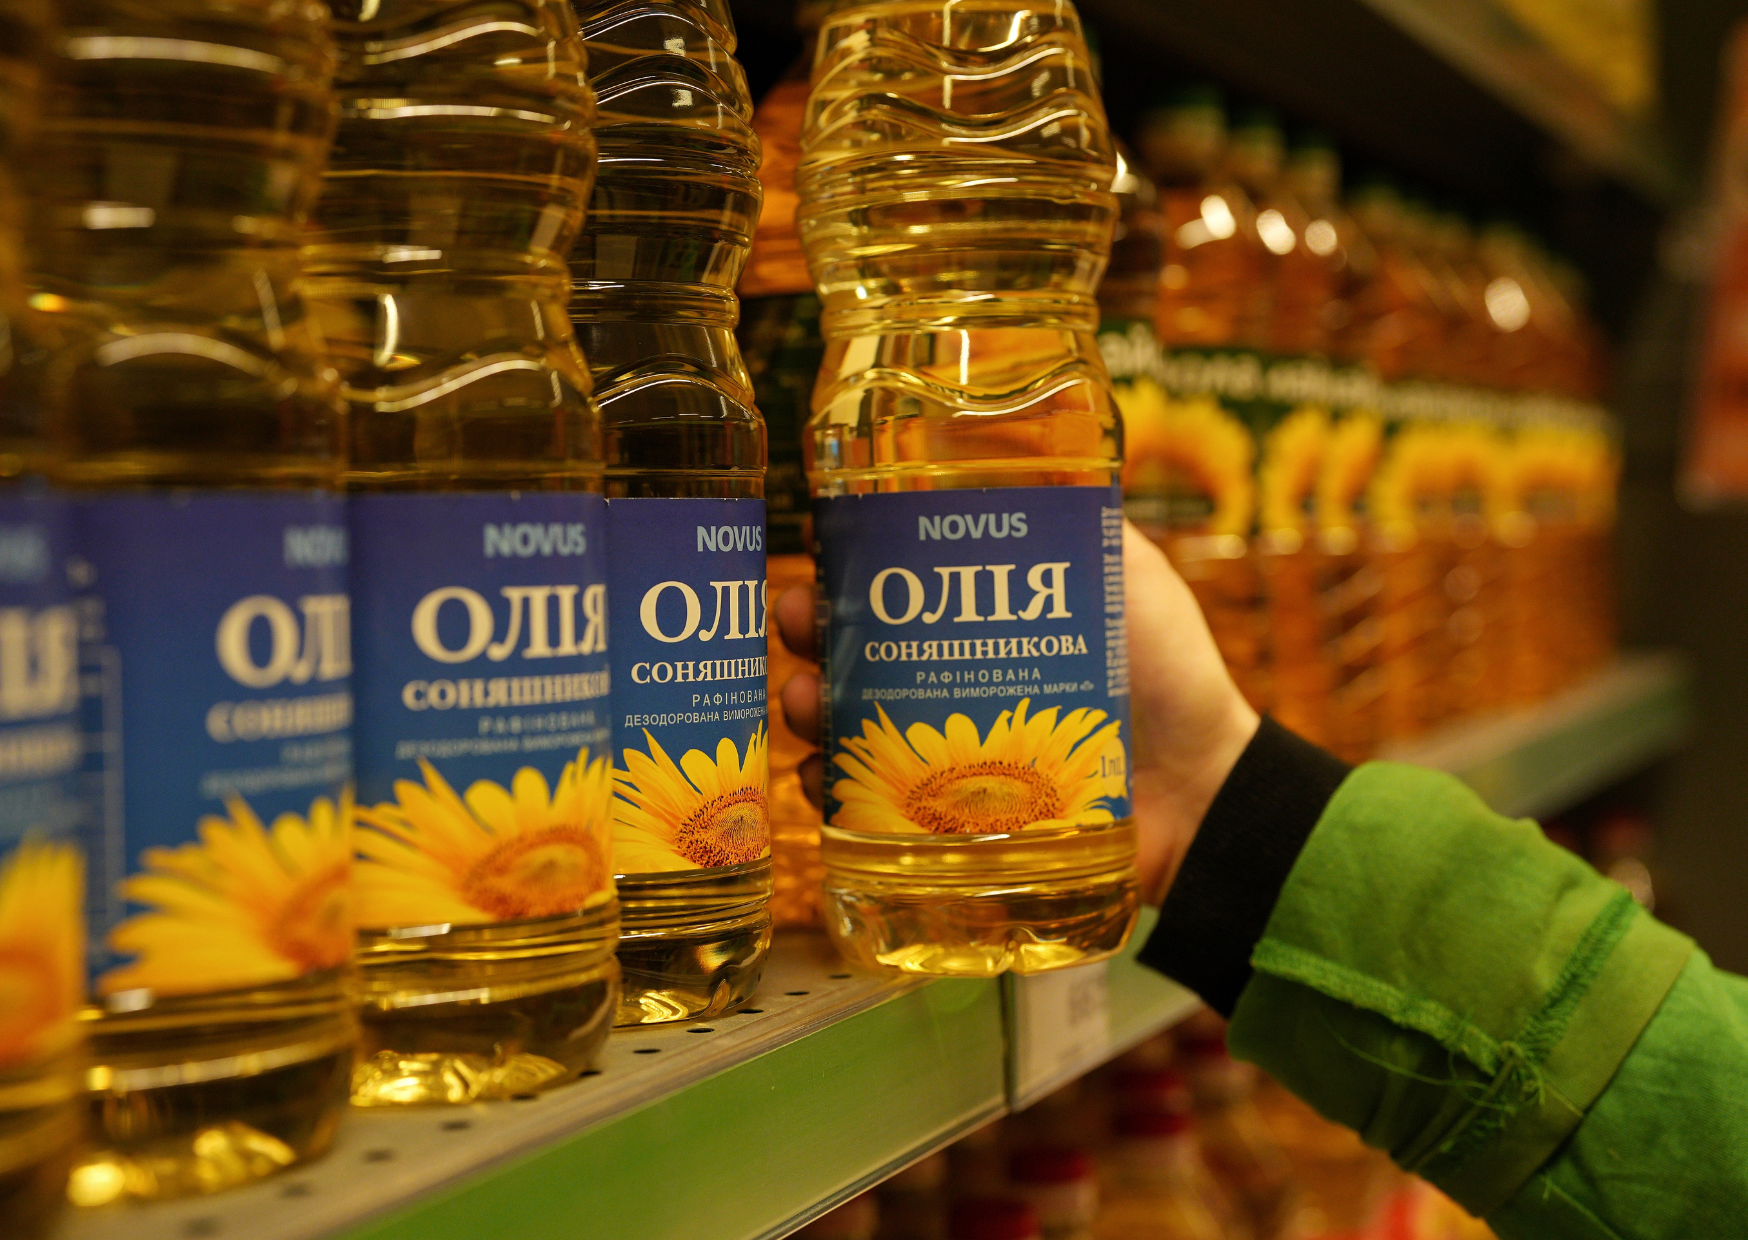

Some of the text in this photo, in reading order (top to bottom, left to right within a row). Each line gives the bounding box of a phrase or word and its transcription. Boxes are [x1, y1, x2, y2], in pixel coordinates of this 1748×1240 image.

[483, 522, 587, 559] NOVUS
[696, 525, 762, 553] NOVUS
[918, 511, 1029, 541] NOVUS
[868, 561, 1073, 626] ОЛІЯ
[410, 583, 608, 665] ОЛІЯ
[864, 633, 1089, 662] СОНЯШНИКОВА
[630, 655, 768, 684] СОНЯШНИКО
[916, 667, 1042, 684] РАФІНОВАНА
[861, 686, 950, 701] ДЕЗОДОРОВАНА
[953, 683, 1041, 699] ВИМОРОЖЕНА
[1043, 681, 1078, 695] МАРКИ
[624, 711, 720, 728] ДЕЗОДОРОВАНА
